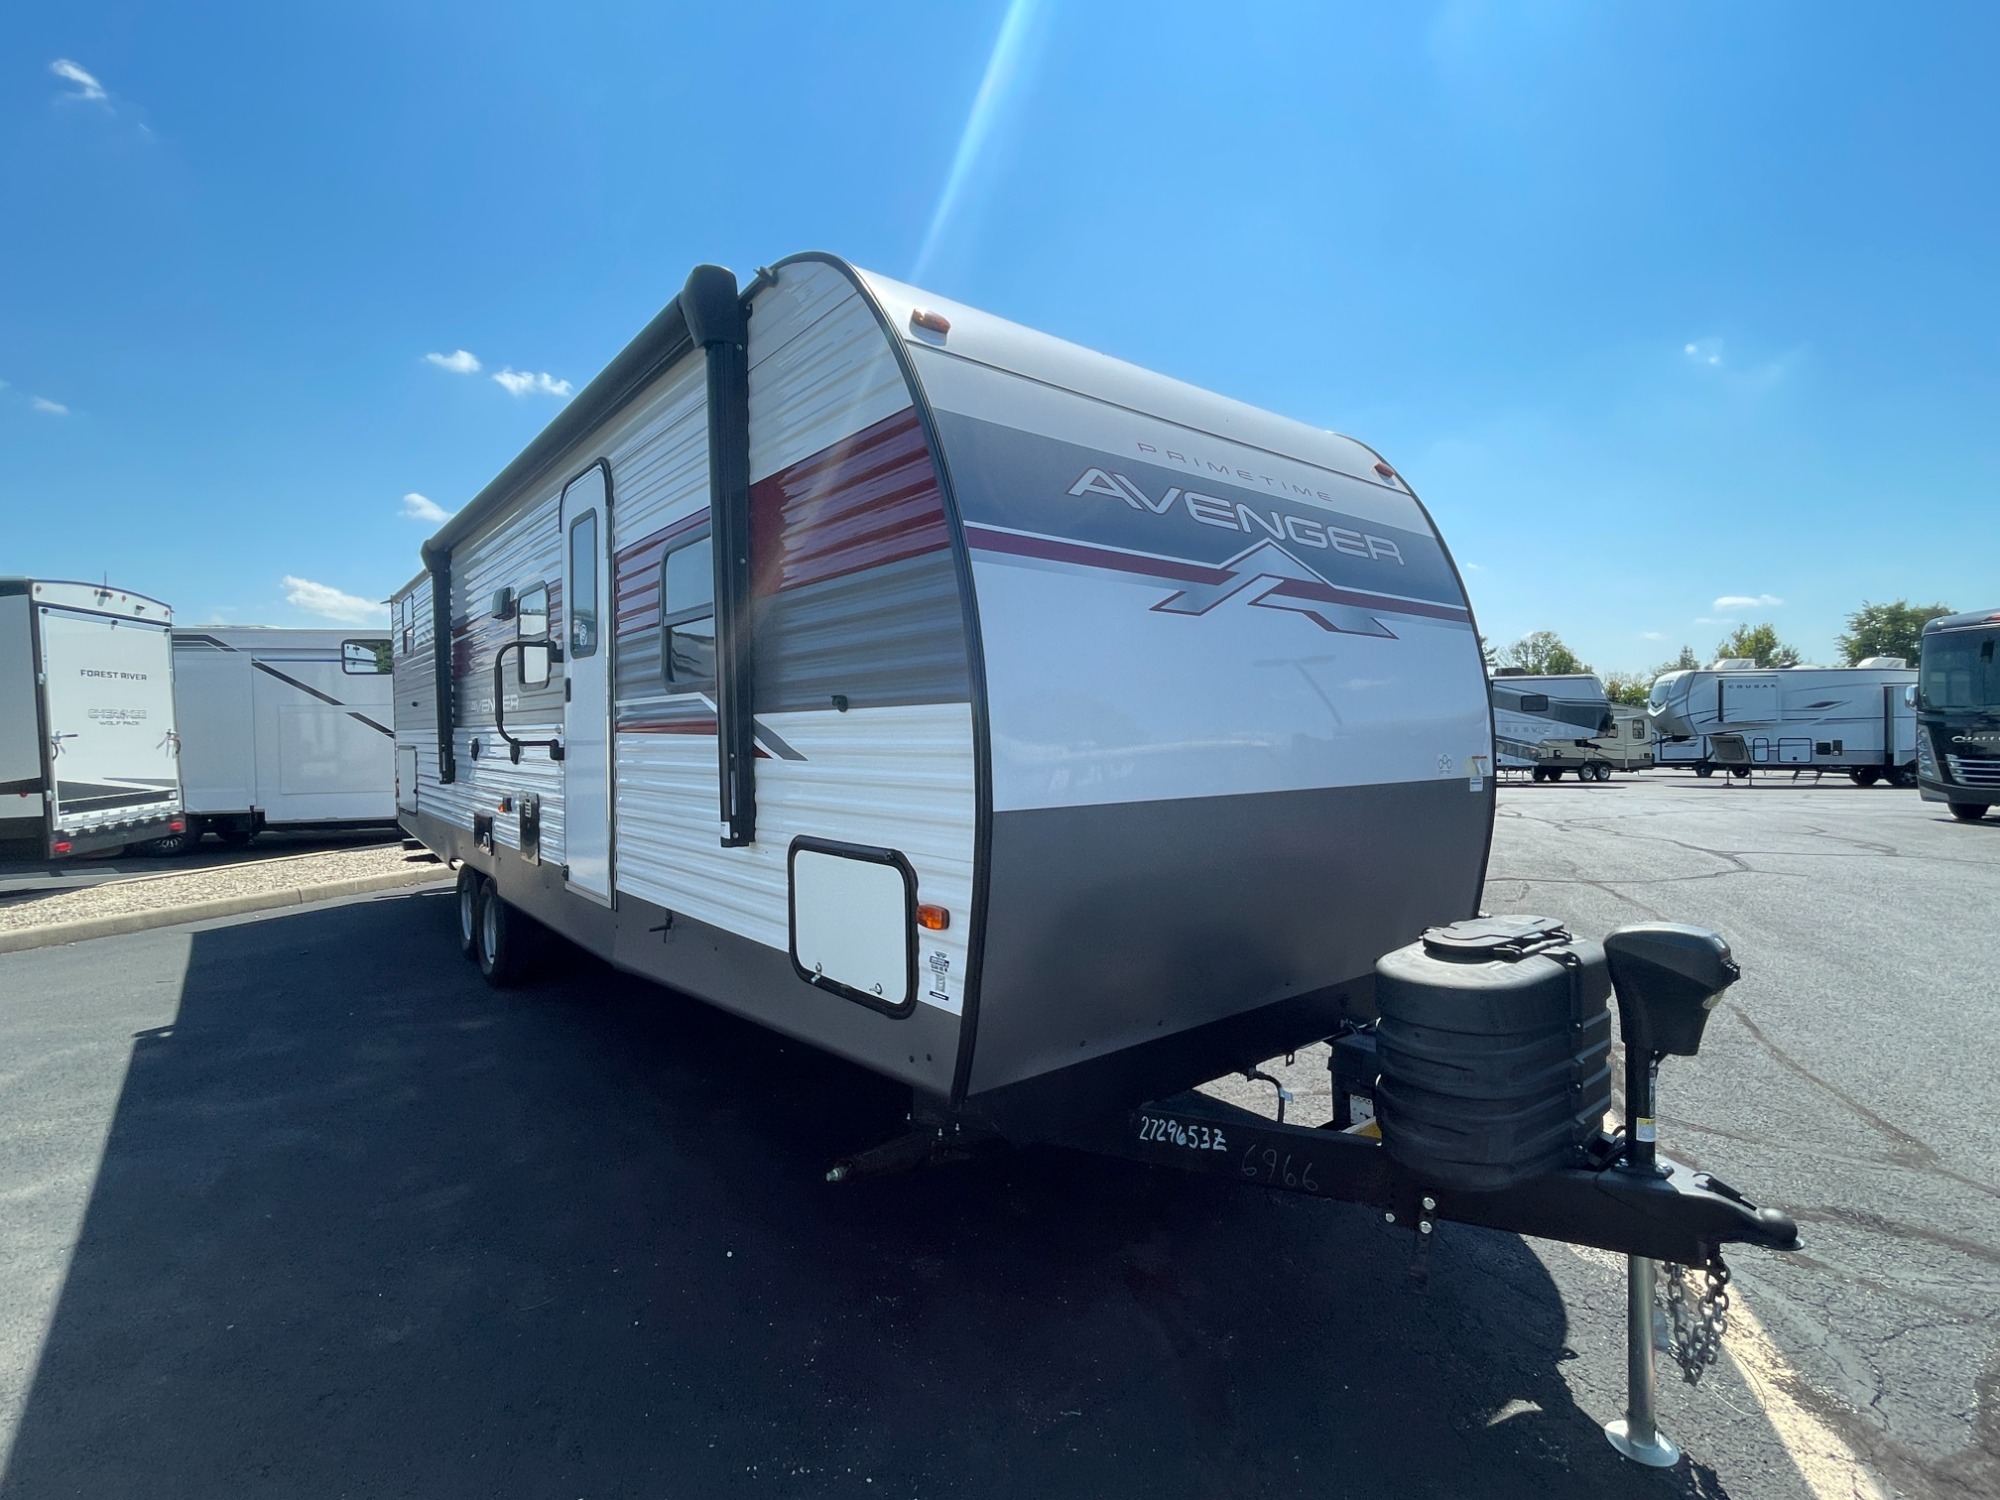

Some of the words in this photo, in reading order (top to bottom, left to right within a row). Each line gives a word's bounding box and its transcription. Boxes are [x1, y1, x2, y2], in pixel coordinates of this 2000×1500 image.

[1137, 442, 1334, 502] PRIMETIME
[1067, 466, 1406, 566] AVENGER
[80, 669, 119, 679] FOREST
[120, 672, 147, 681] RIVER
[471, 693, 519, 712] AVENER
[1240, 1144, 1319, 1192] 6966
